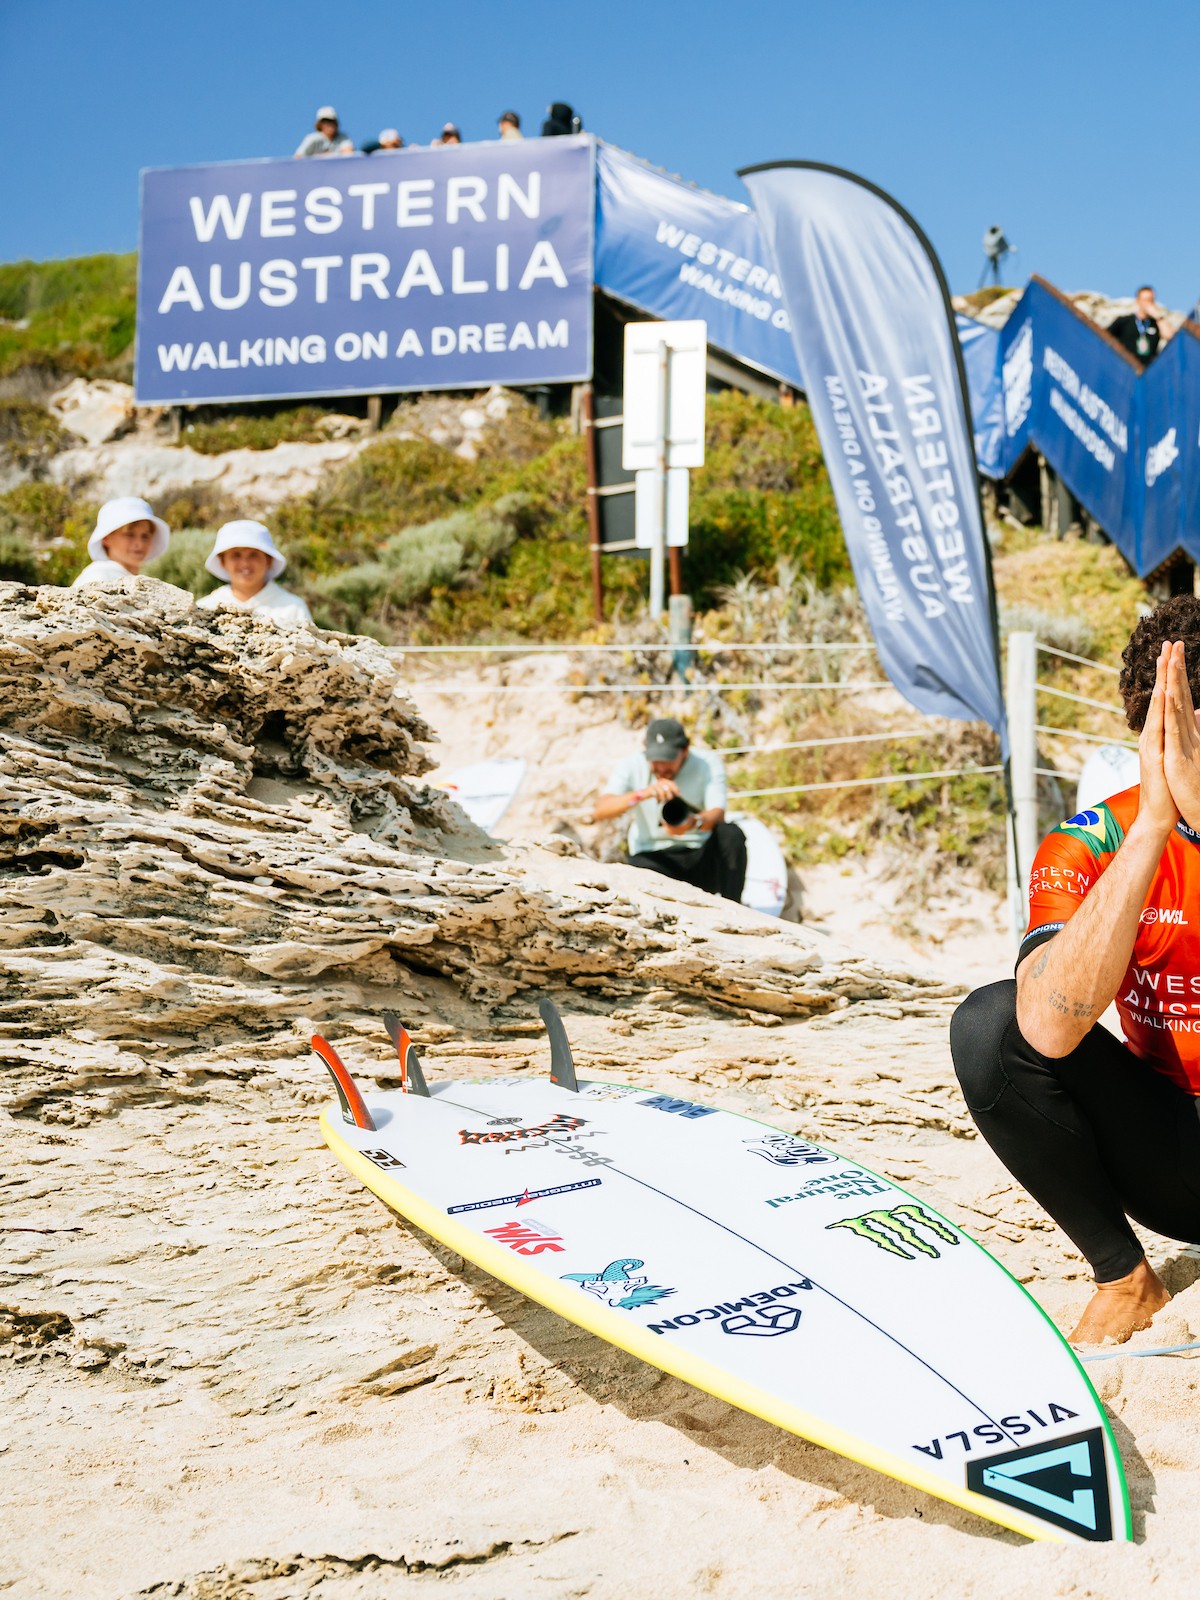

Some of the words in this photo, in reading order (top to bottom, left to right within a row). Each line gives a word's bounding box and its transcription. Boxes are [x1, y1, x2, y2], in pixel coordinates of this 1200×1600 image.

[188, 171, 541, 243] WESTERN
[157, 240, 569, 315] AUSTRALIA
[679, 262, 773, 322] WALKING
[771, 309, 792, 333] O
[157, 334, 327, 373] WALKING
[341, 329, 389, 361] ON
[396, 325, 424, 359] A
[431, 319, 570, 357] DREAM
[1158, 909, 1189, 925] WSL
[360, 1149, 407, 1170] FCS
[765, 1176, 879, 1209] Natural
[834, 1184, 893, 1200] The
[646, 1277, 814, 1335] ADEMICON
[911, 1402, 1080, 1460] VISSLA
